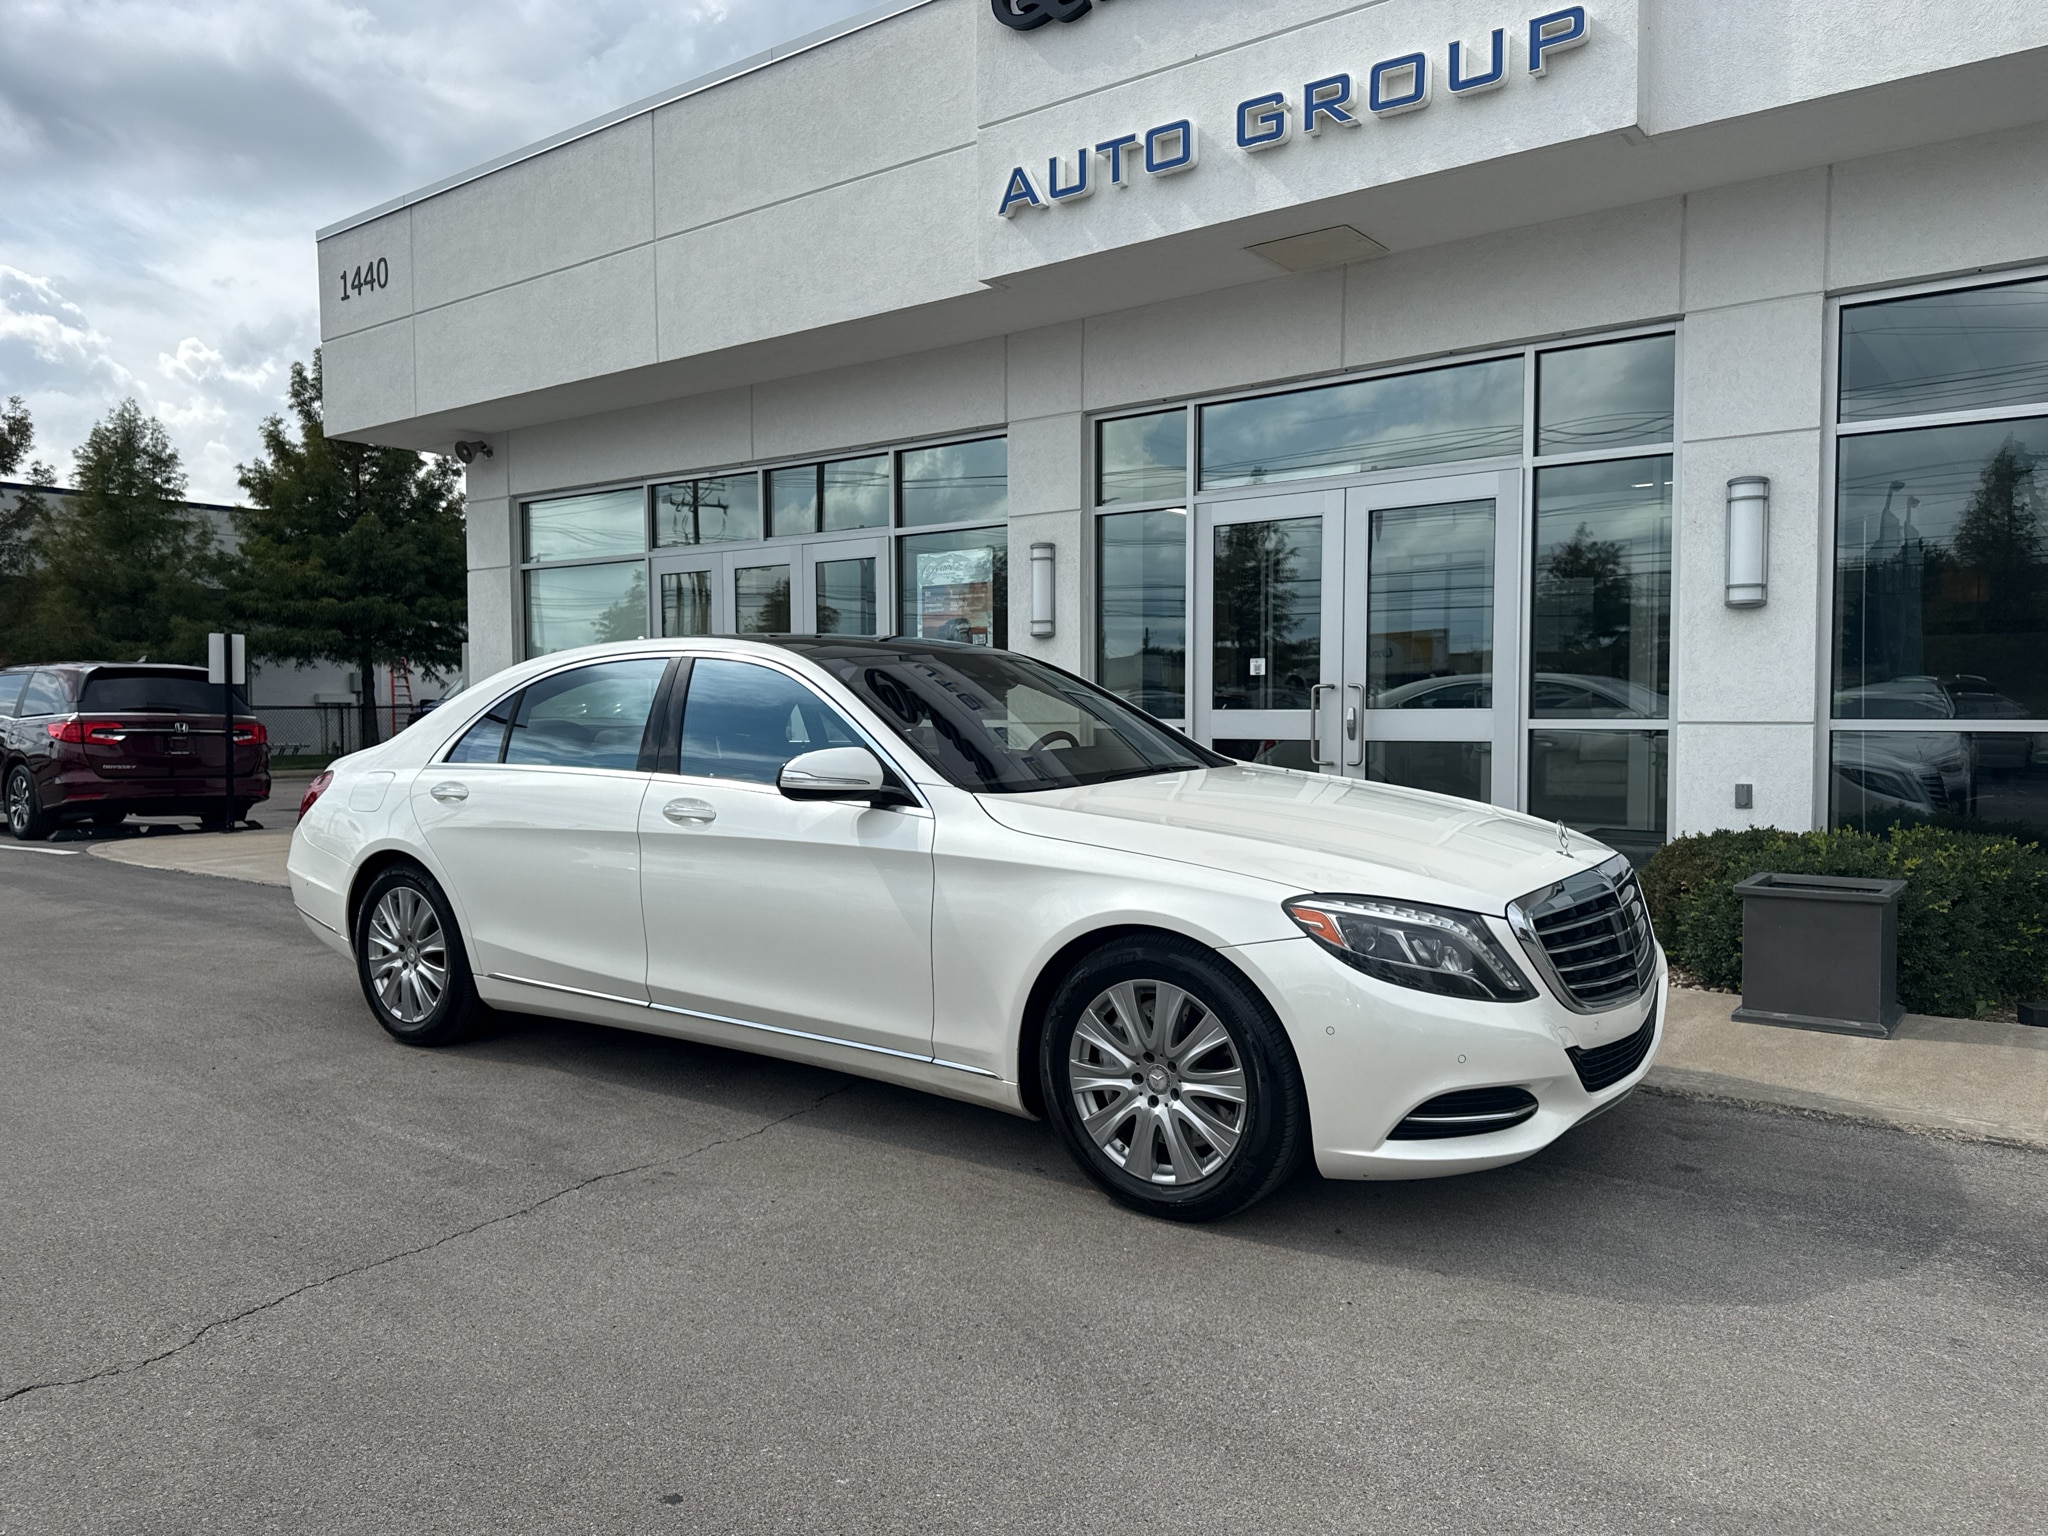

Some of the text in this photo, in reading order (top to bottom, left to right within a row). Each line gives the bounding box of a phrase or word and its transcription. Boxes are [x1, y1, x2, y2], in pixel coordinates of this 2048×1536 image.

[998, 5, 1591, 218] AUTO GROUP
[340, 257, 389, 301] 1440
